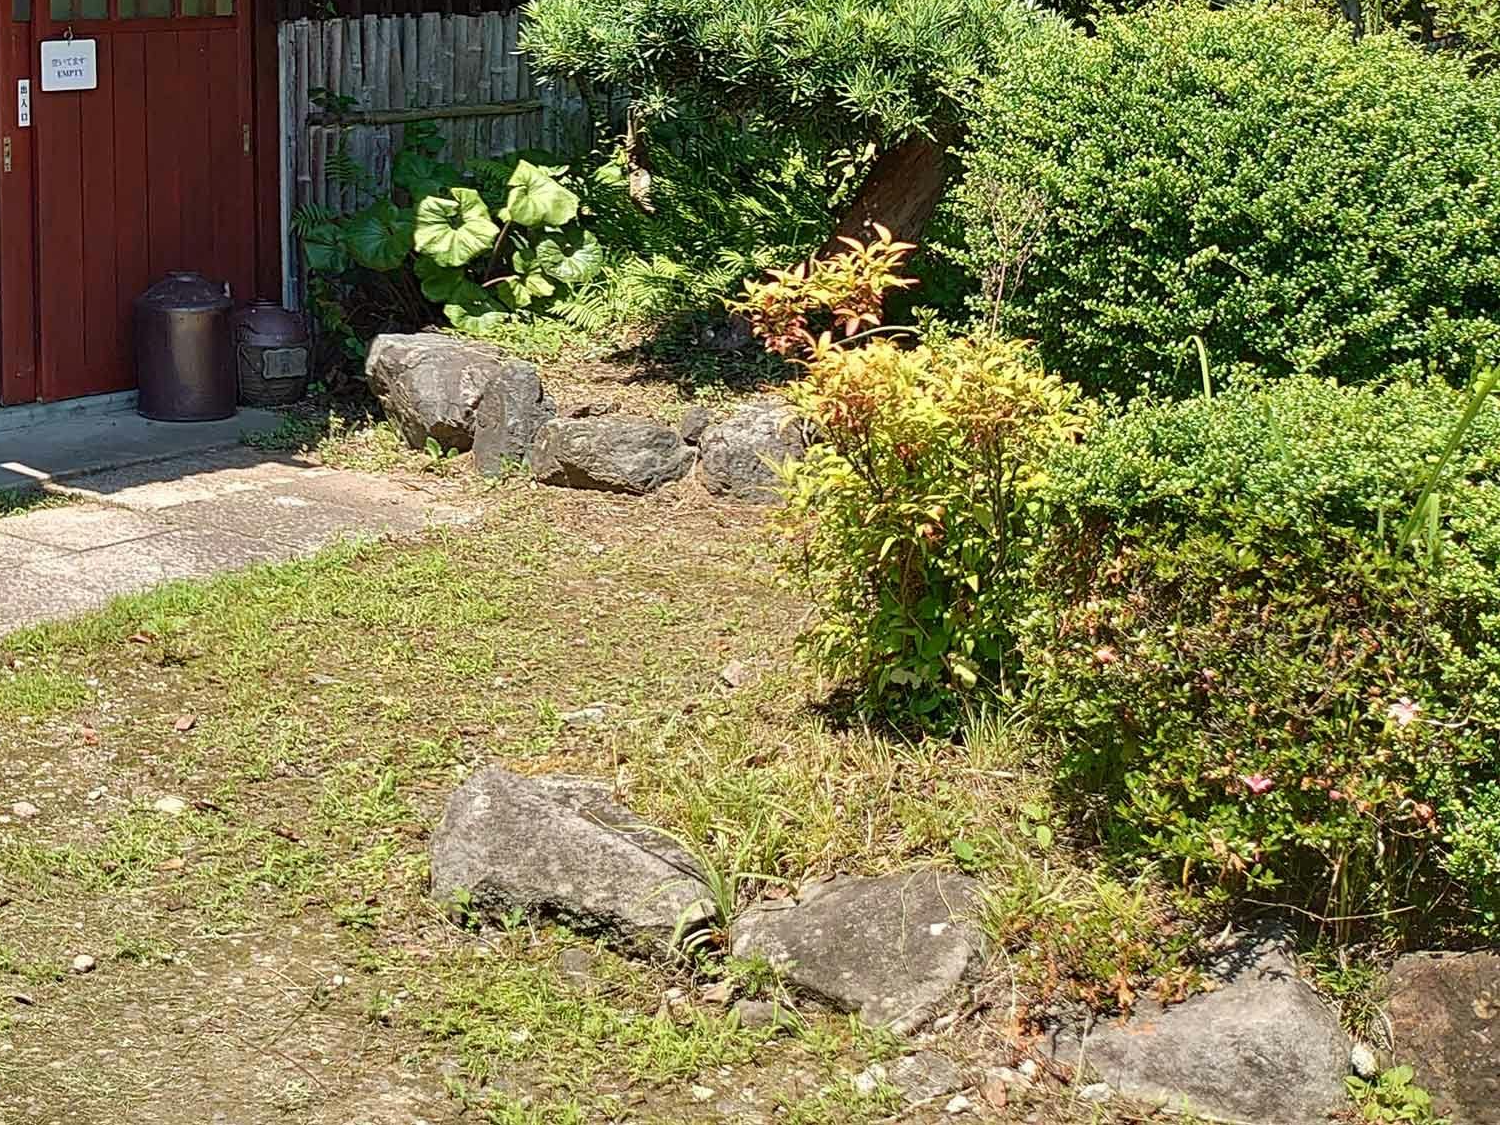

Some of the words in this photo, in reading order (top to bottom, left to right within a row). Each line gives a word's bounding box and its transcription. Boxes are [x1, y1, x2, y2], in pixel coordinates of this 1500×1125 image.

[57, 68, 84, 78] EMPTY
[20, 85, 28, 122] 出入口
